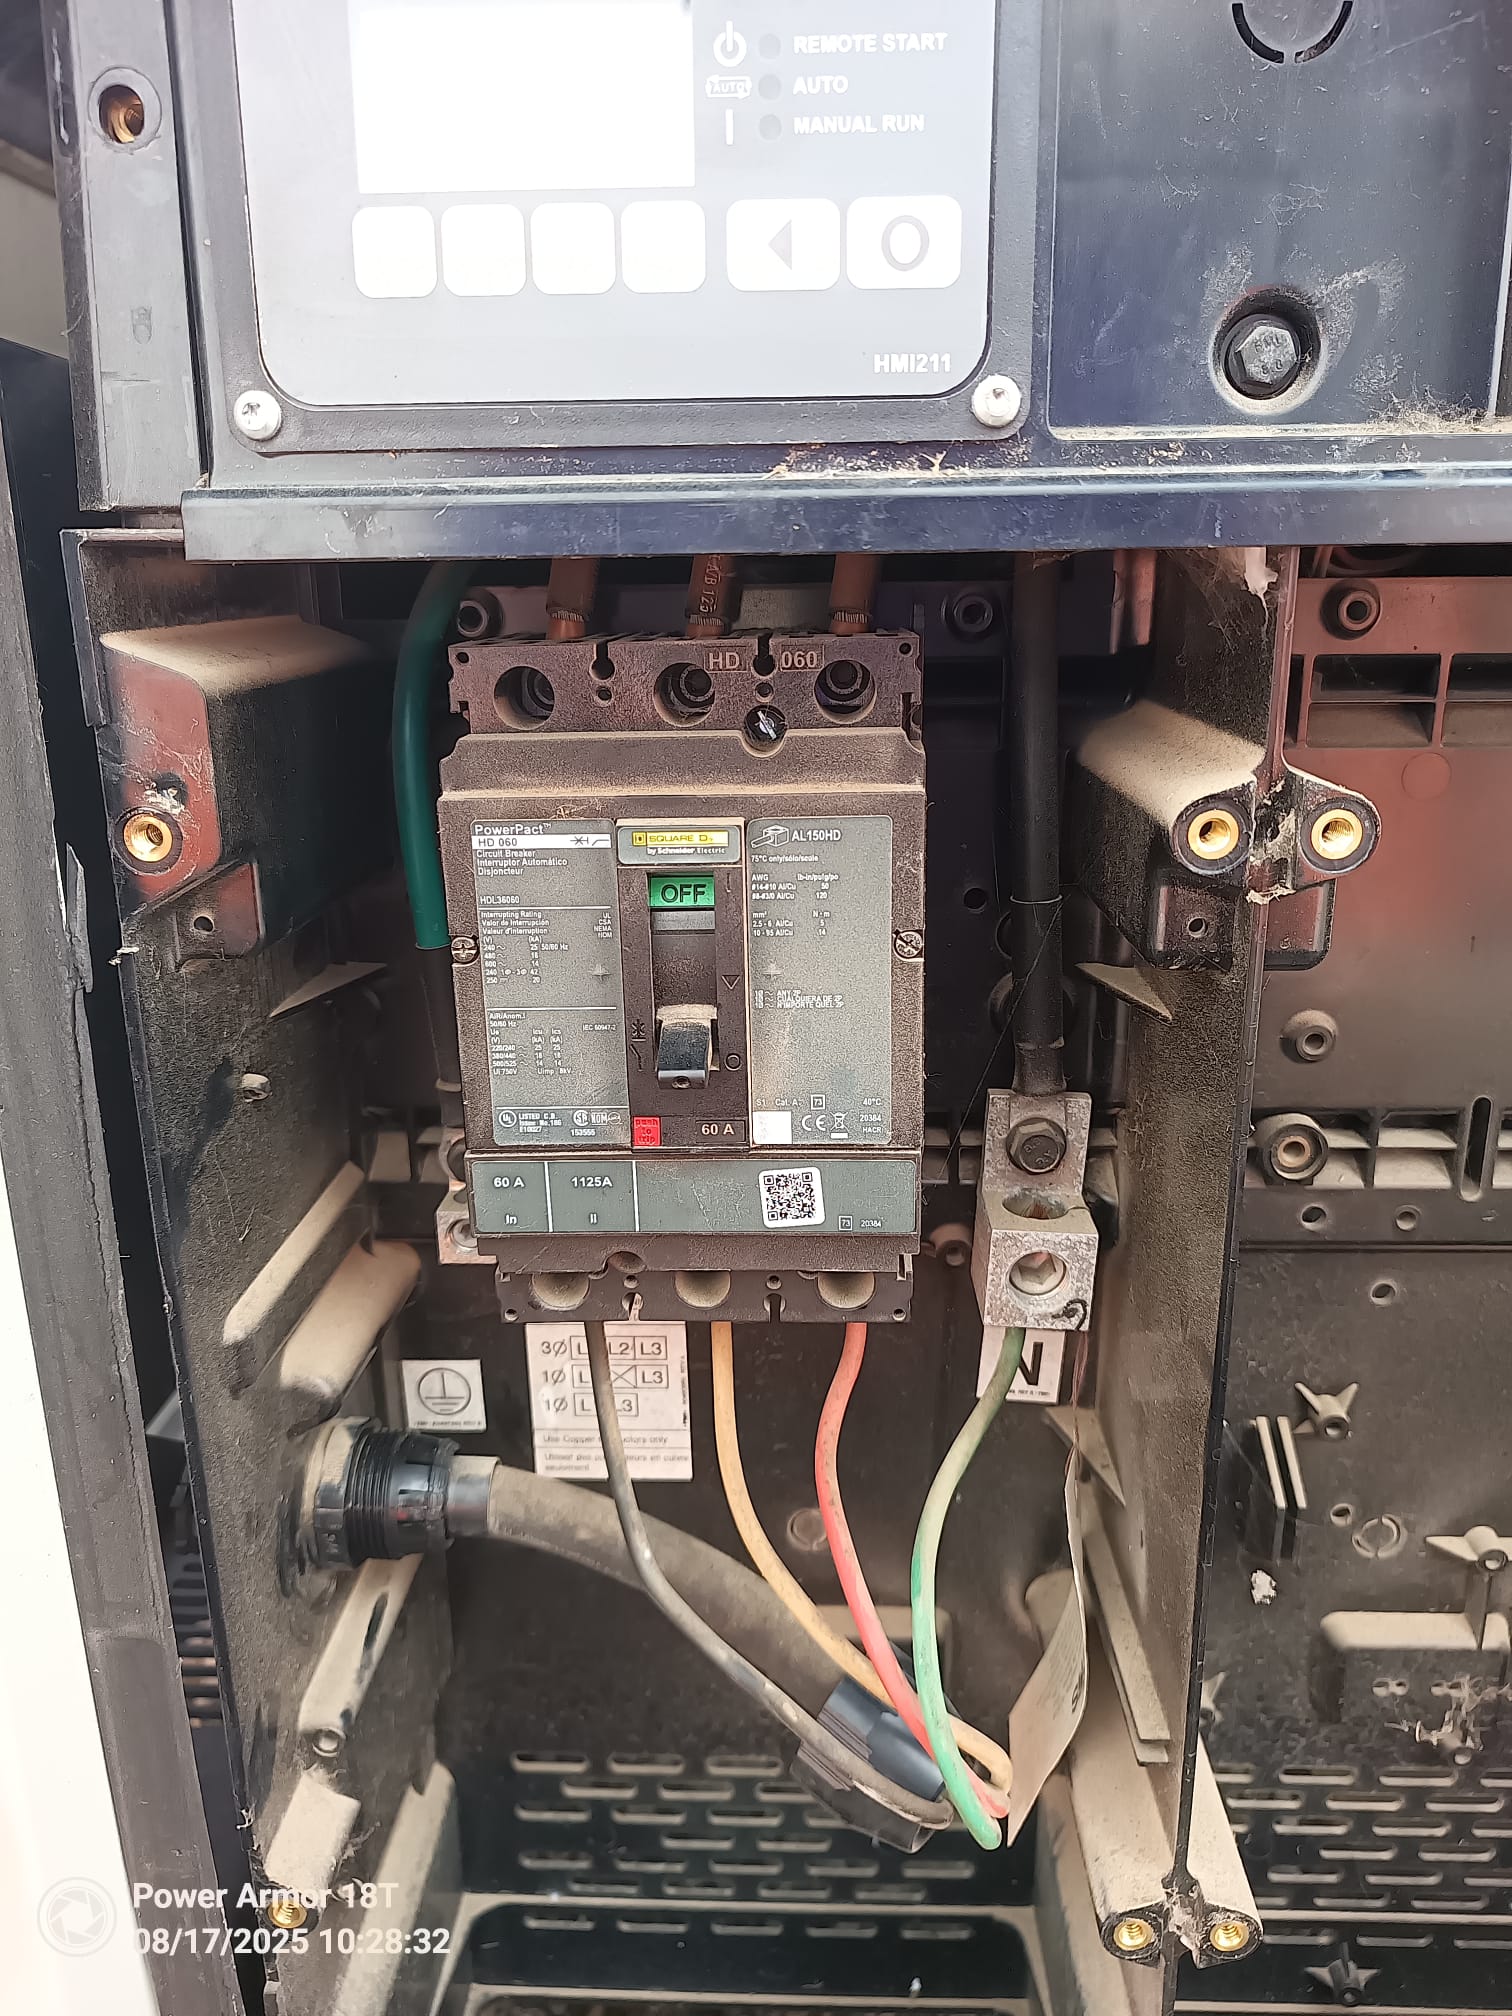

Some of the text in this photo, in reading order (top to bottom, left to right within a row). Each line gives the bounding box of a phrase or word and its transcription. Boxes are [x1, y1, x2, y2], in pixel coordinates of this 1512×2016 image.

[793, 32, 948, 54] REMOTE START
[713, 80, 744, 94] AUTO
[793, 75, 849, 95] AUTO
[793, 113, 925, 134] MANUAL RUN
[873, 353, 951, 373] HMI211
[708, 650, 818, 670] HD 060
[791, 829, 842, 842] AL150HD
[478, 838, 518, 847] HD 060
[476, 850, 536, 858] Circuit Breaker
[647, 847, 657, 856] by
[657, 847, 695, 855] Schneider
[477, 859, 568, 868] Interruptor Automático
[478, 867, 524, 877] Disjoncteur
[752, 874, 770, 882] AWG
[661, 884, 707, 904] OFF
[815, 891, 828, 899] 120
[480, 911, 519, 920] Interrupting
[801, 1114, 826, 1131] CE
[702, 1124, 735, 1135] 60 A
[493, 1176, 525, 1188] 60 A
[571, 1176, 613, 1188] 1125A
[608, 1342, 630, 1356] L2
[641, 1342, 662, 1356] L3
[642, 1370, 664, 1384] L3
